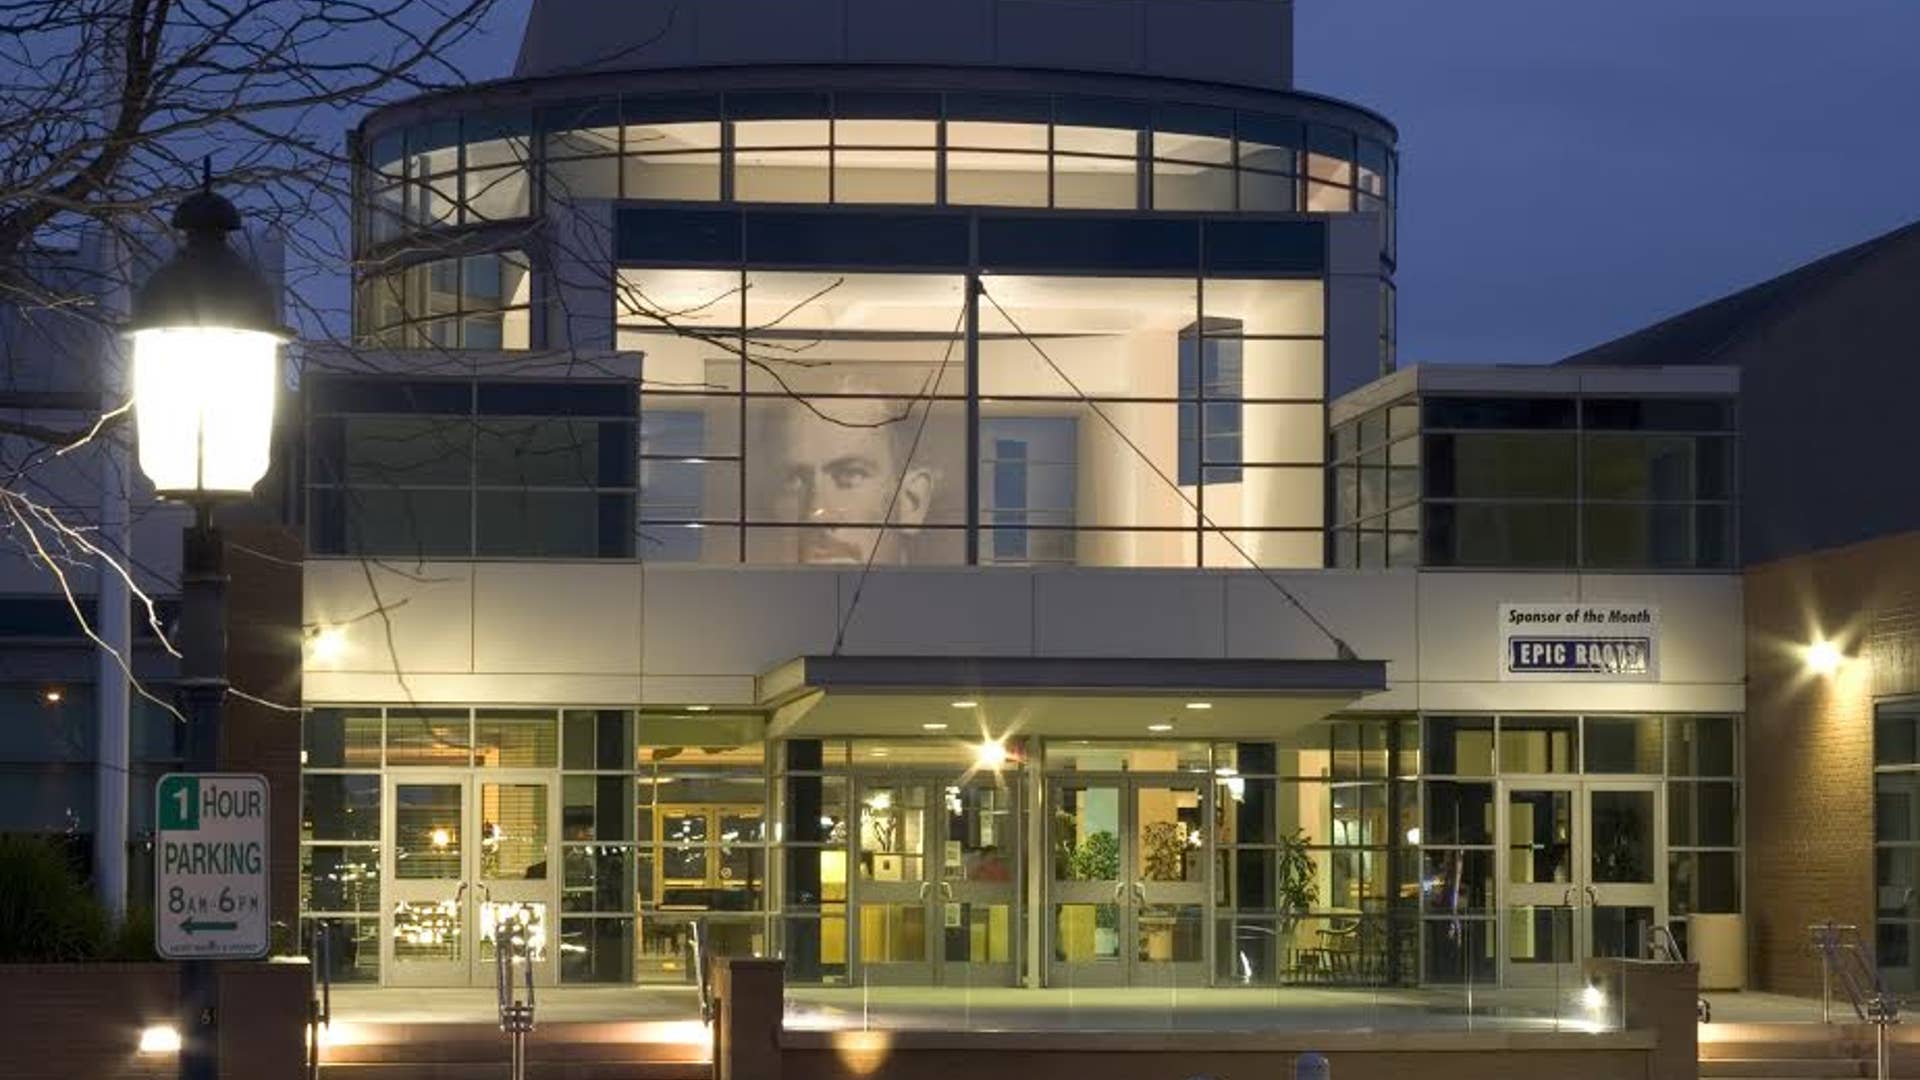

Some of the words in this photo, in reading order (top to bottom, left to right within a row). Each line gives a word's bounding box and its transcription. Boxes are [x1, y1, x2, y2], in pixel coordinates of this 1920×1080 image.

[1508, 609, 1561, 625] Sponsor
[1565, 609, 1580, 623] of
[1583, 609, 1605, 623] the
[1607, 609, 1651, 623] Month
[1520, 643, 1567, 665] EPIC
[173, 787, 189, 820] 1
[203, 789, 261, 819] HOUR
[165, 842, 261, 875] PARKING
